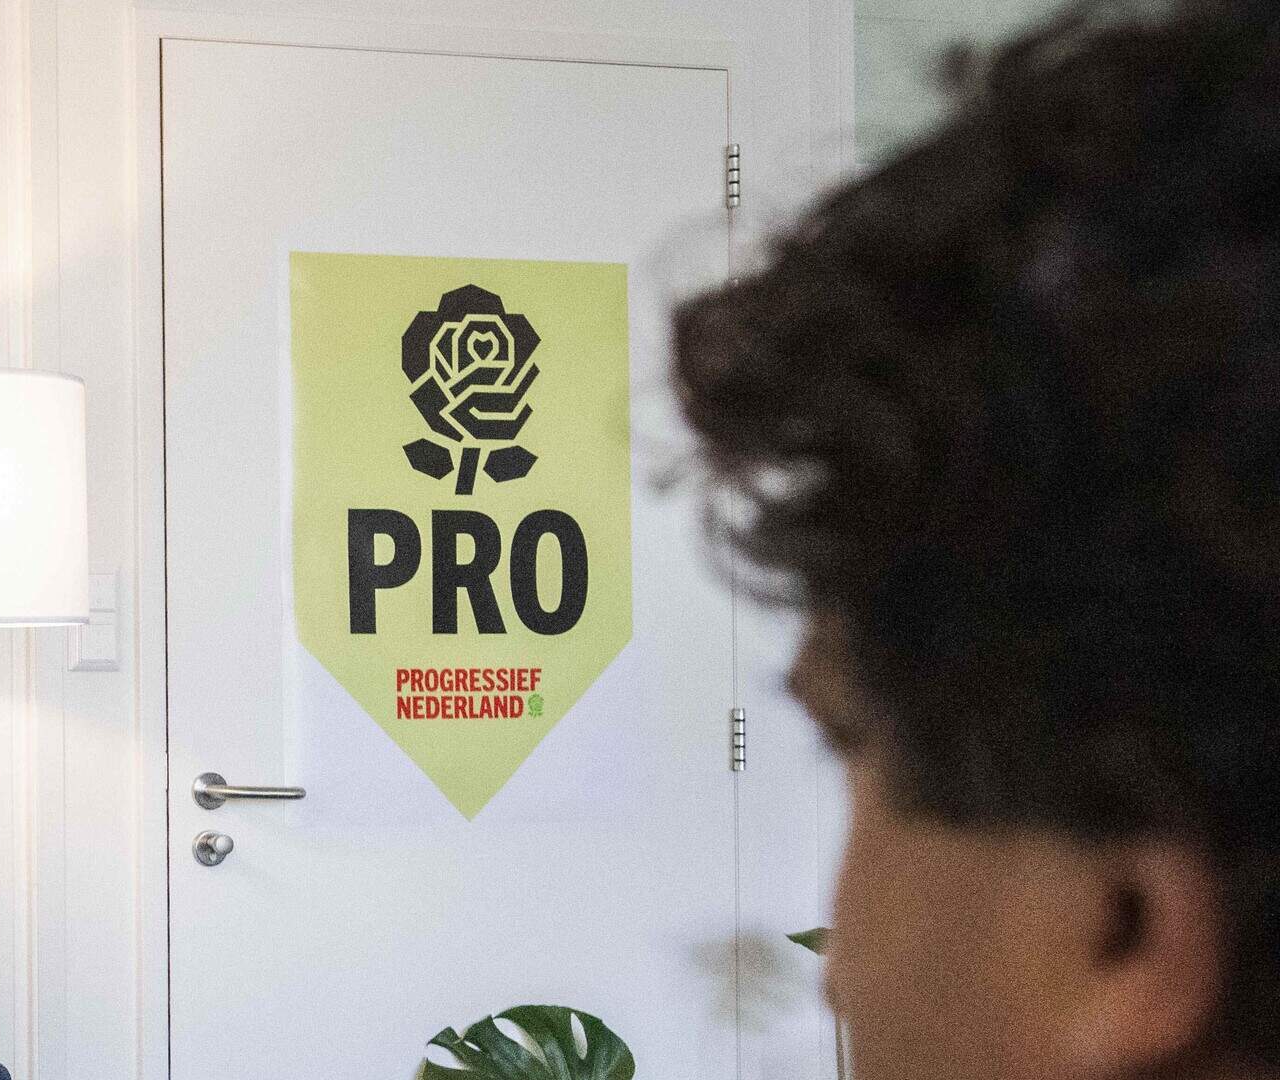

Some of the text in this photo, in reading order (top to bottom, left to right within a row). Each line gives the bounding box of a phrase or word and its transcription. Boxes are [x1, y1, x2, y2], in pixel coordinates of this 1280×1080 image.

[347, 508, 589, 636] PRO
[396, 668, 542, 692] PROGRESSIEF
[396, 695, 524, 719] NEDERLAND
